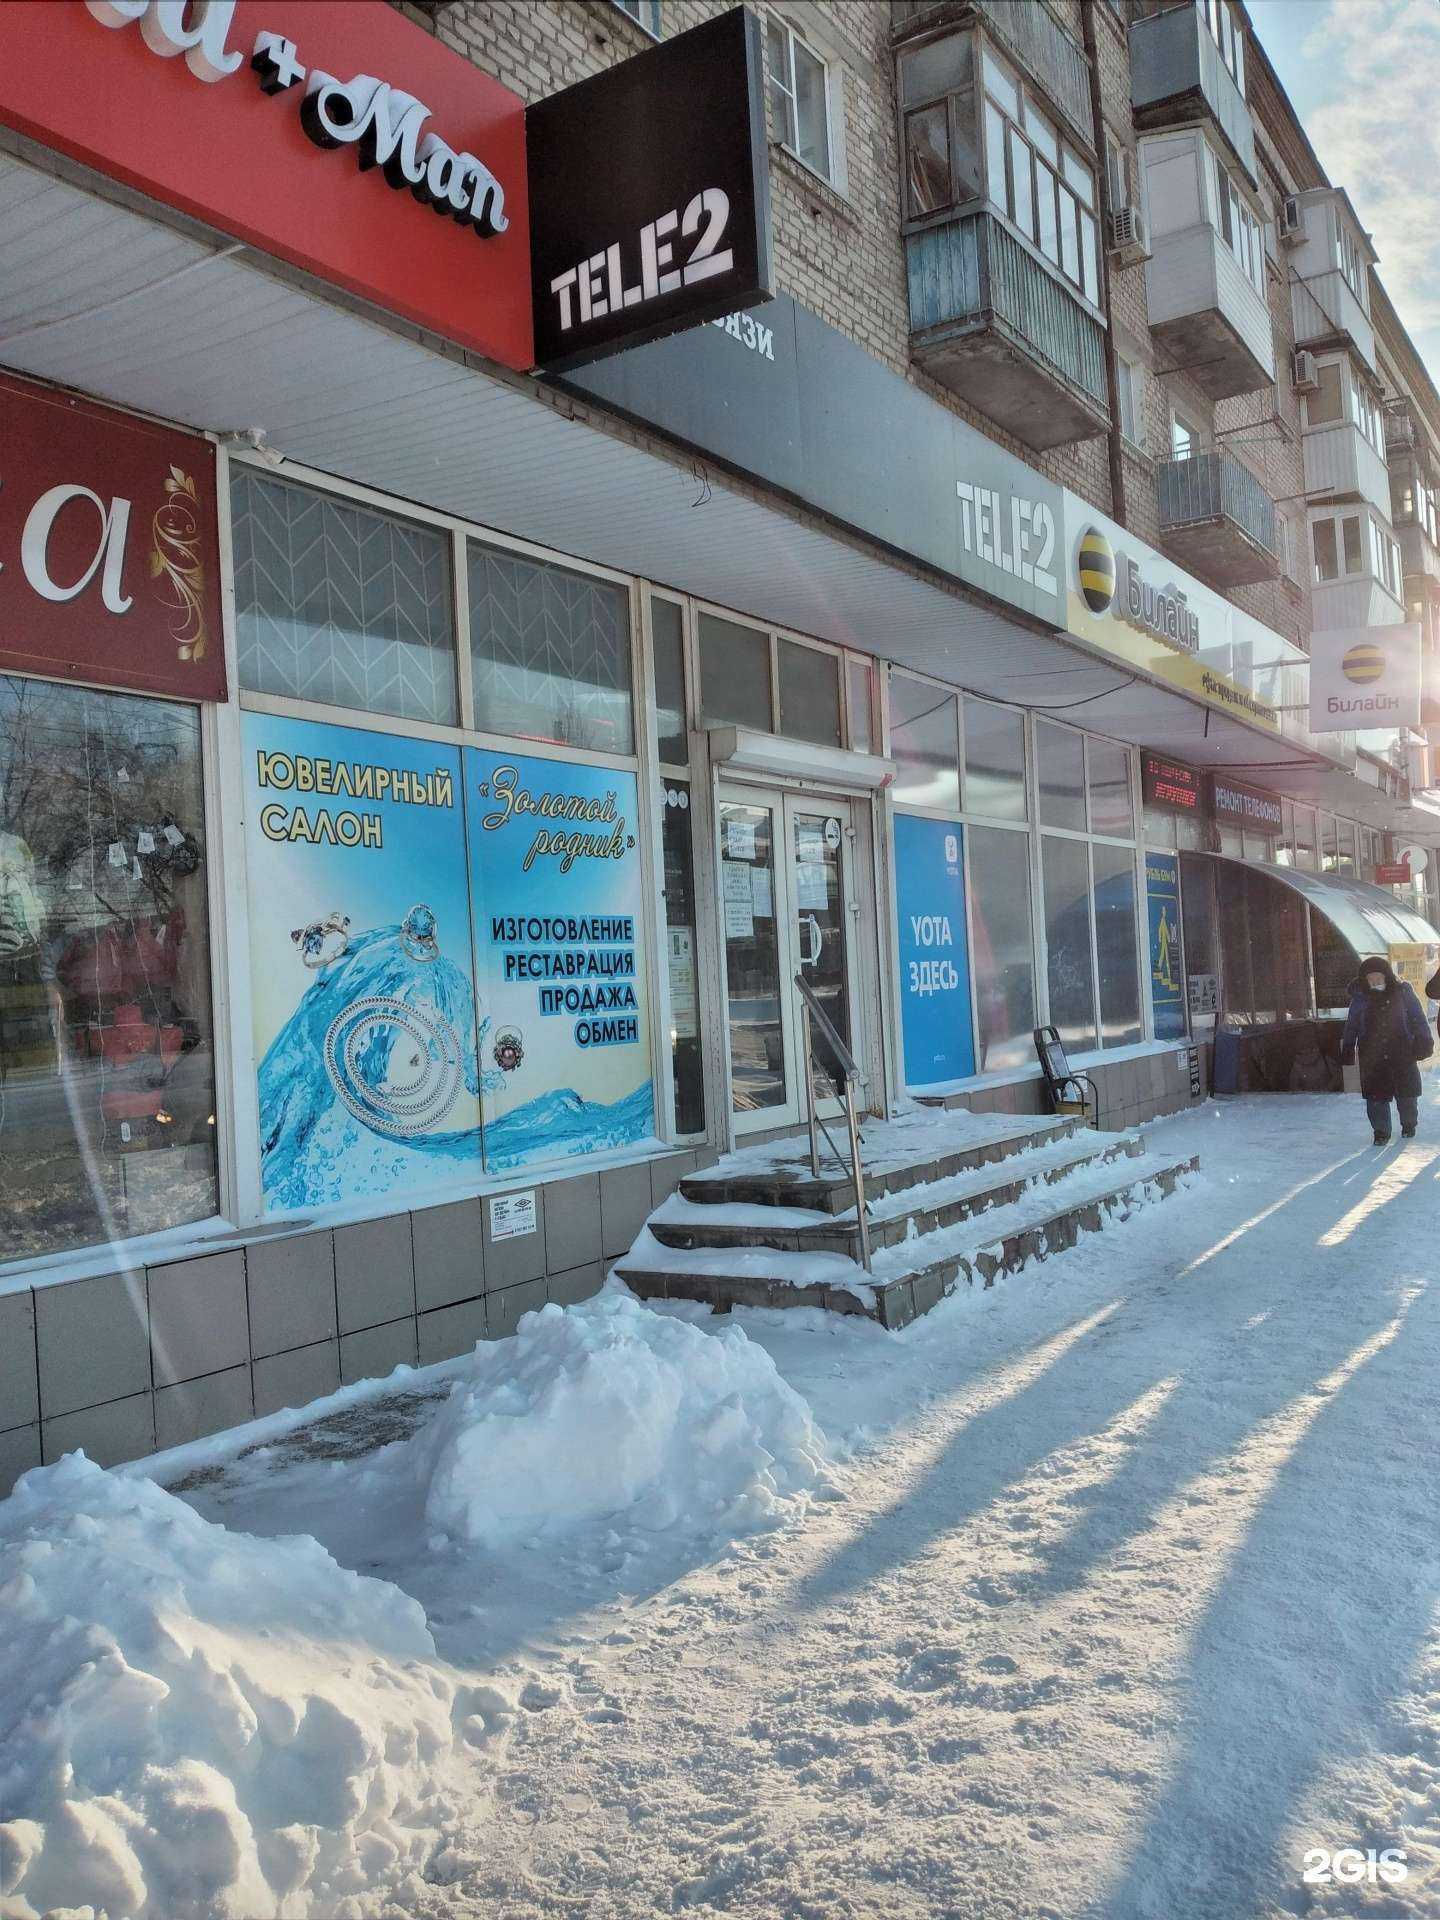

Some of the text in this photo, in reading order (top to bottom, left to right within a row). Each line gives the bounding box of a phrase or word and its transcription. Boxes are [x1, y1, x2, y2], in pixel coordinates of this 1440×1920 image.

[549, 187, 733, 331] TELE2
[956, 480, 1058, 597] TELE2
[1124, 556, 1200, 652] Билайн
[1326, 693, 1399, 714] Билайн
[256, 750, 454, 809] ЮВЕЛИРНЫЙ
[260, 803, 383, 849] САЛОН
[491, 917, 633, 941] ИЗГОТОВЛЕНИЕ
[910, 916, 952, 947] YOTA
[505, 952, 634, 978] РЕСТАВРАЦИЯ
[909, 960, 959, 997] ЗДЕСЬ
[541, 986, 636, 1012] ПРОДАЖА
[576, 1019, 637, 1045] ОБМЕН
